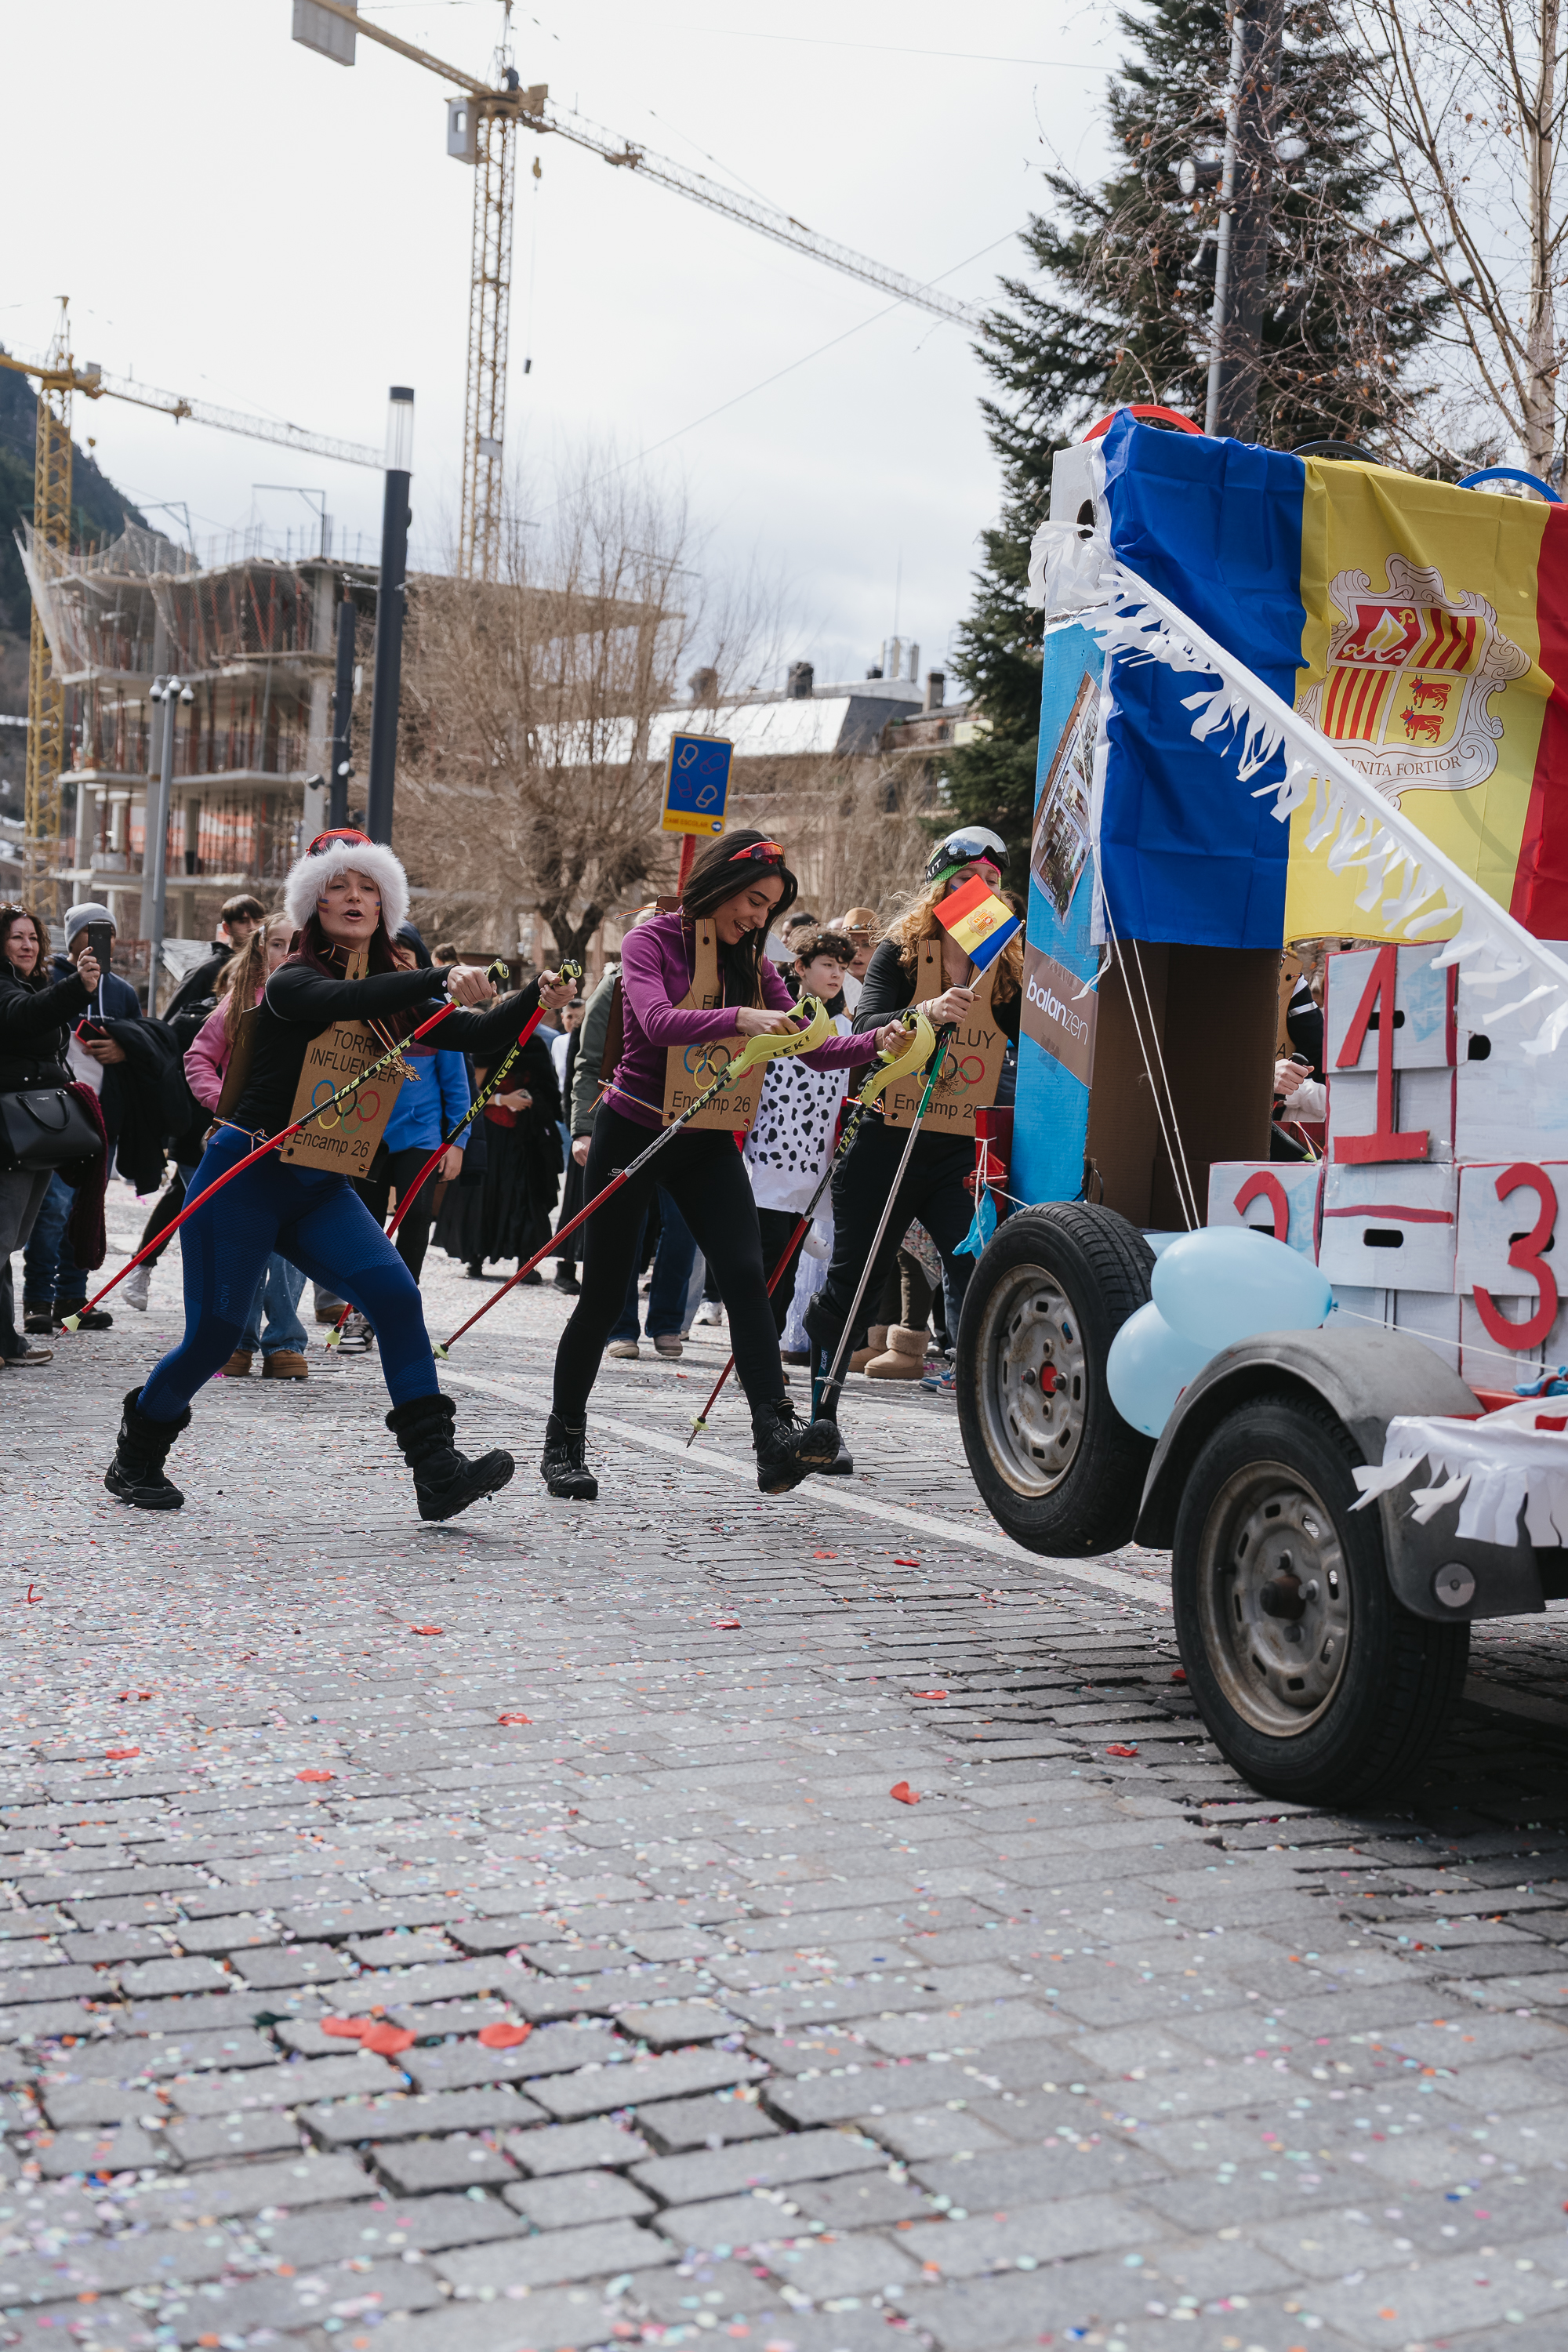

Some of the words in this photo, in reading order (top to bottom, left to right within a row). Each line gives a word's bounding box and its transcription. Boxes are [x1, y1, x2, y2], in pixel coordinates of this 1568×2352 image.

[1396, 756, 1462, 776] FORTIOR
[1026, 974, 1088, 1045] balanzen
[334, 1029, 390, 1058] TORR
[772, 1034, 811, 1058] LEKI
[310, 1047, 398, 1084] INFLUENER
[494, 1049, 520, 1085] LEKI
[466, 1085, 492, 1122] LEKI
[733, 1095, 751, 1112] 26
[292, 1127, 348, 1157] Encamp
[350, 1139, 370, 1158] 26
[839, 1116, 860, 1152] LEKI
[1472, 1161, 1558, 1351] 3
